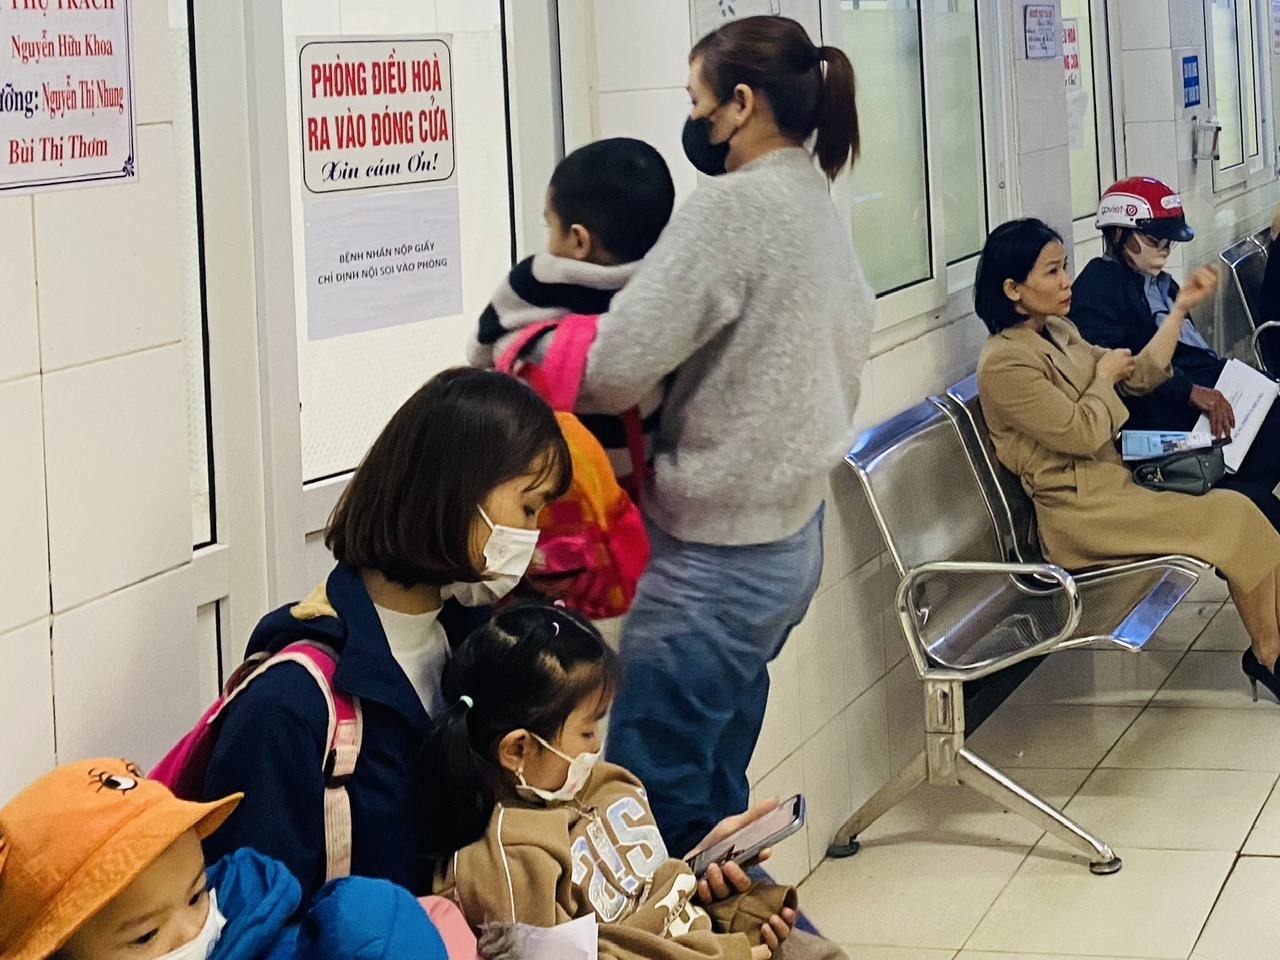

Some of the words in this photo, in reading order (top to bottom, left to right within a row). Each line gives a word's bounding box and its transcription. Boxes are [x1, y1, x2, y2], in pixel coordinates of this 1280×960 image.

[11, 30, 55, 64] Nguyễn
[58, 34, 82, 58] Hữu
[85, 34, 113, 57] Khoa
[311, 53, 367, 98] PHÒNG
[372, 48, 407, 95] ĐIỀU
[412, 52, 442, 93] HOÀ
[42, 76, 77, 119] Nguyễn
[79, 80, 95, 117] Thị
[96, 79, 124, 115] Nhung
[307, 116, 331, 152] RA
[335, 107, 367, 150] VÀO
[371, 105, 414, 147] ĐÓNG
[419, 95, 449, 143] CỬA
[9, 137, 35, 165] Bùi
[39, 136, 63, 167] Thị
[68, 135, 109, 160] Thơm
[321, 160, 360, 183] Xin
[339, 250, 364, 264] BỆNH
[366, 247, 392, 260] NHÂN
[394, 243, 413, 257] NỘP
[414, 239, 435, 253] GIẤY
[336, 270, 359, 283] ĐỊNH
[361, 265, 379, 280] NỘI
[380, 265, 394, 276] SOI
[395, 259, 415, 273] VÀO
[417, 256, 448, 271] PHÒNG
